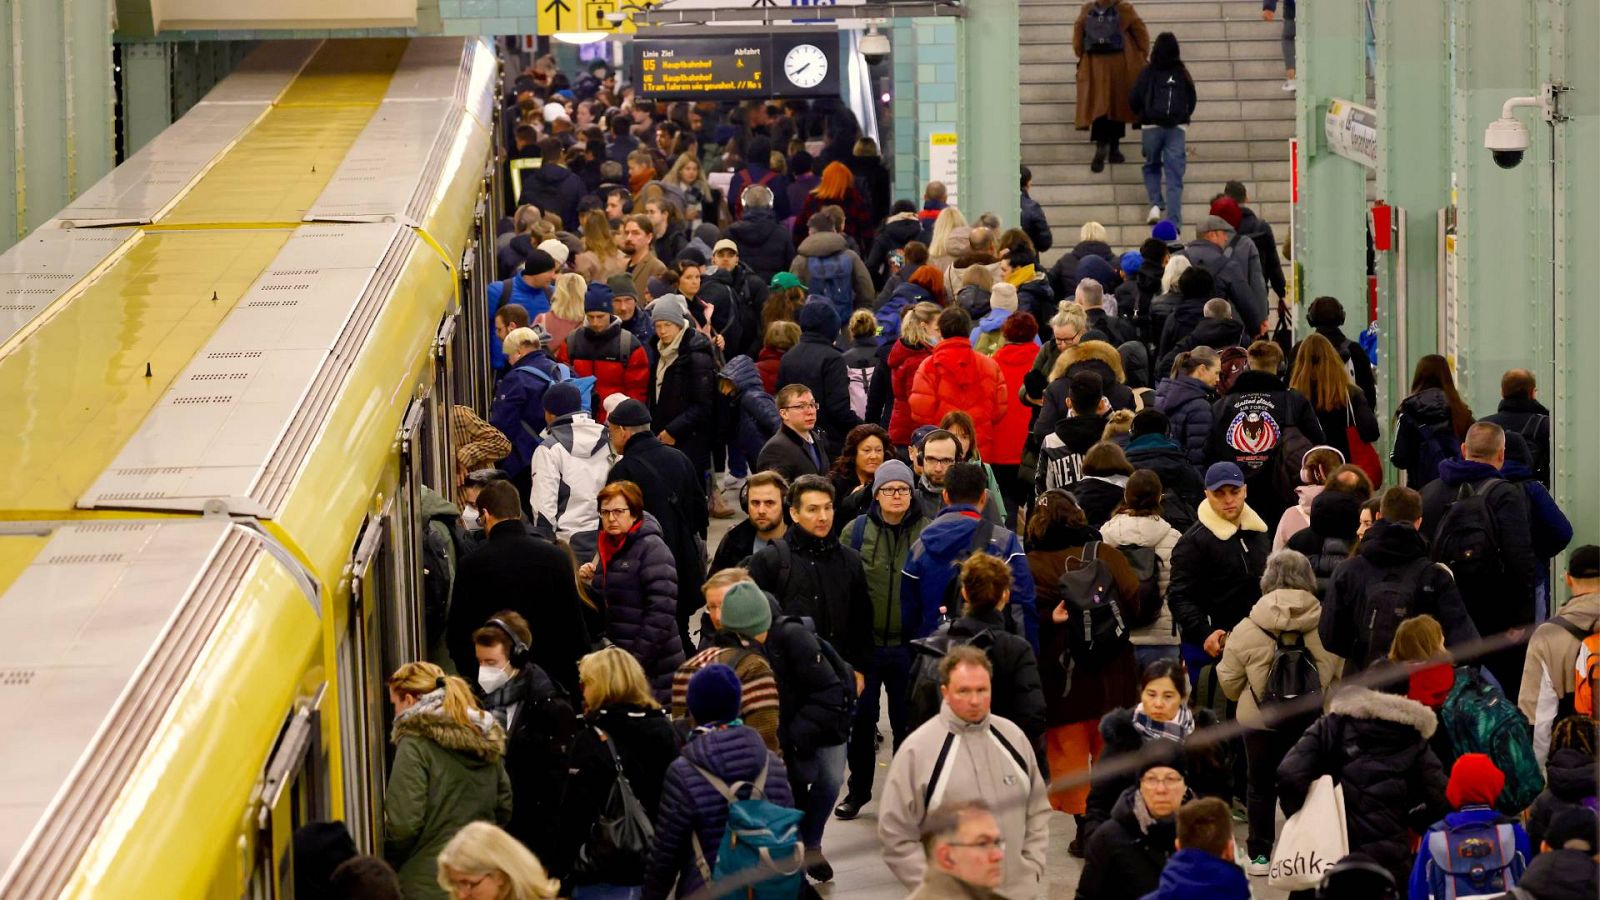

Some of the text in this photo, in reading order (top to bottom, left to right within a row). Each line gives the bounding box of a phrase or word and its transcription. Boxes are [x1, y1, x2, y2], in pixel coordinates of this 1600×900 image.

[642, 48, 761, 58] Linie Ziel Abfahrt
[642, 59, 712, 71] U5 Hauptbahnhof
[662, 73, 713, 82] Hauptbahnhof
